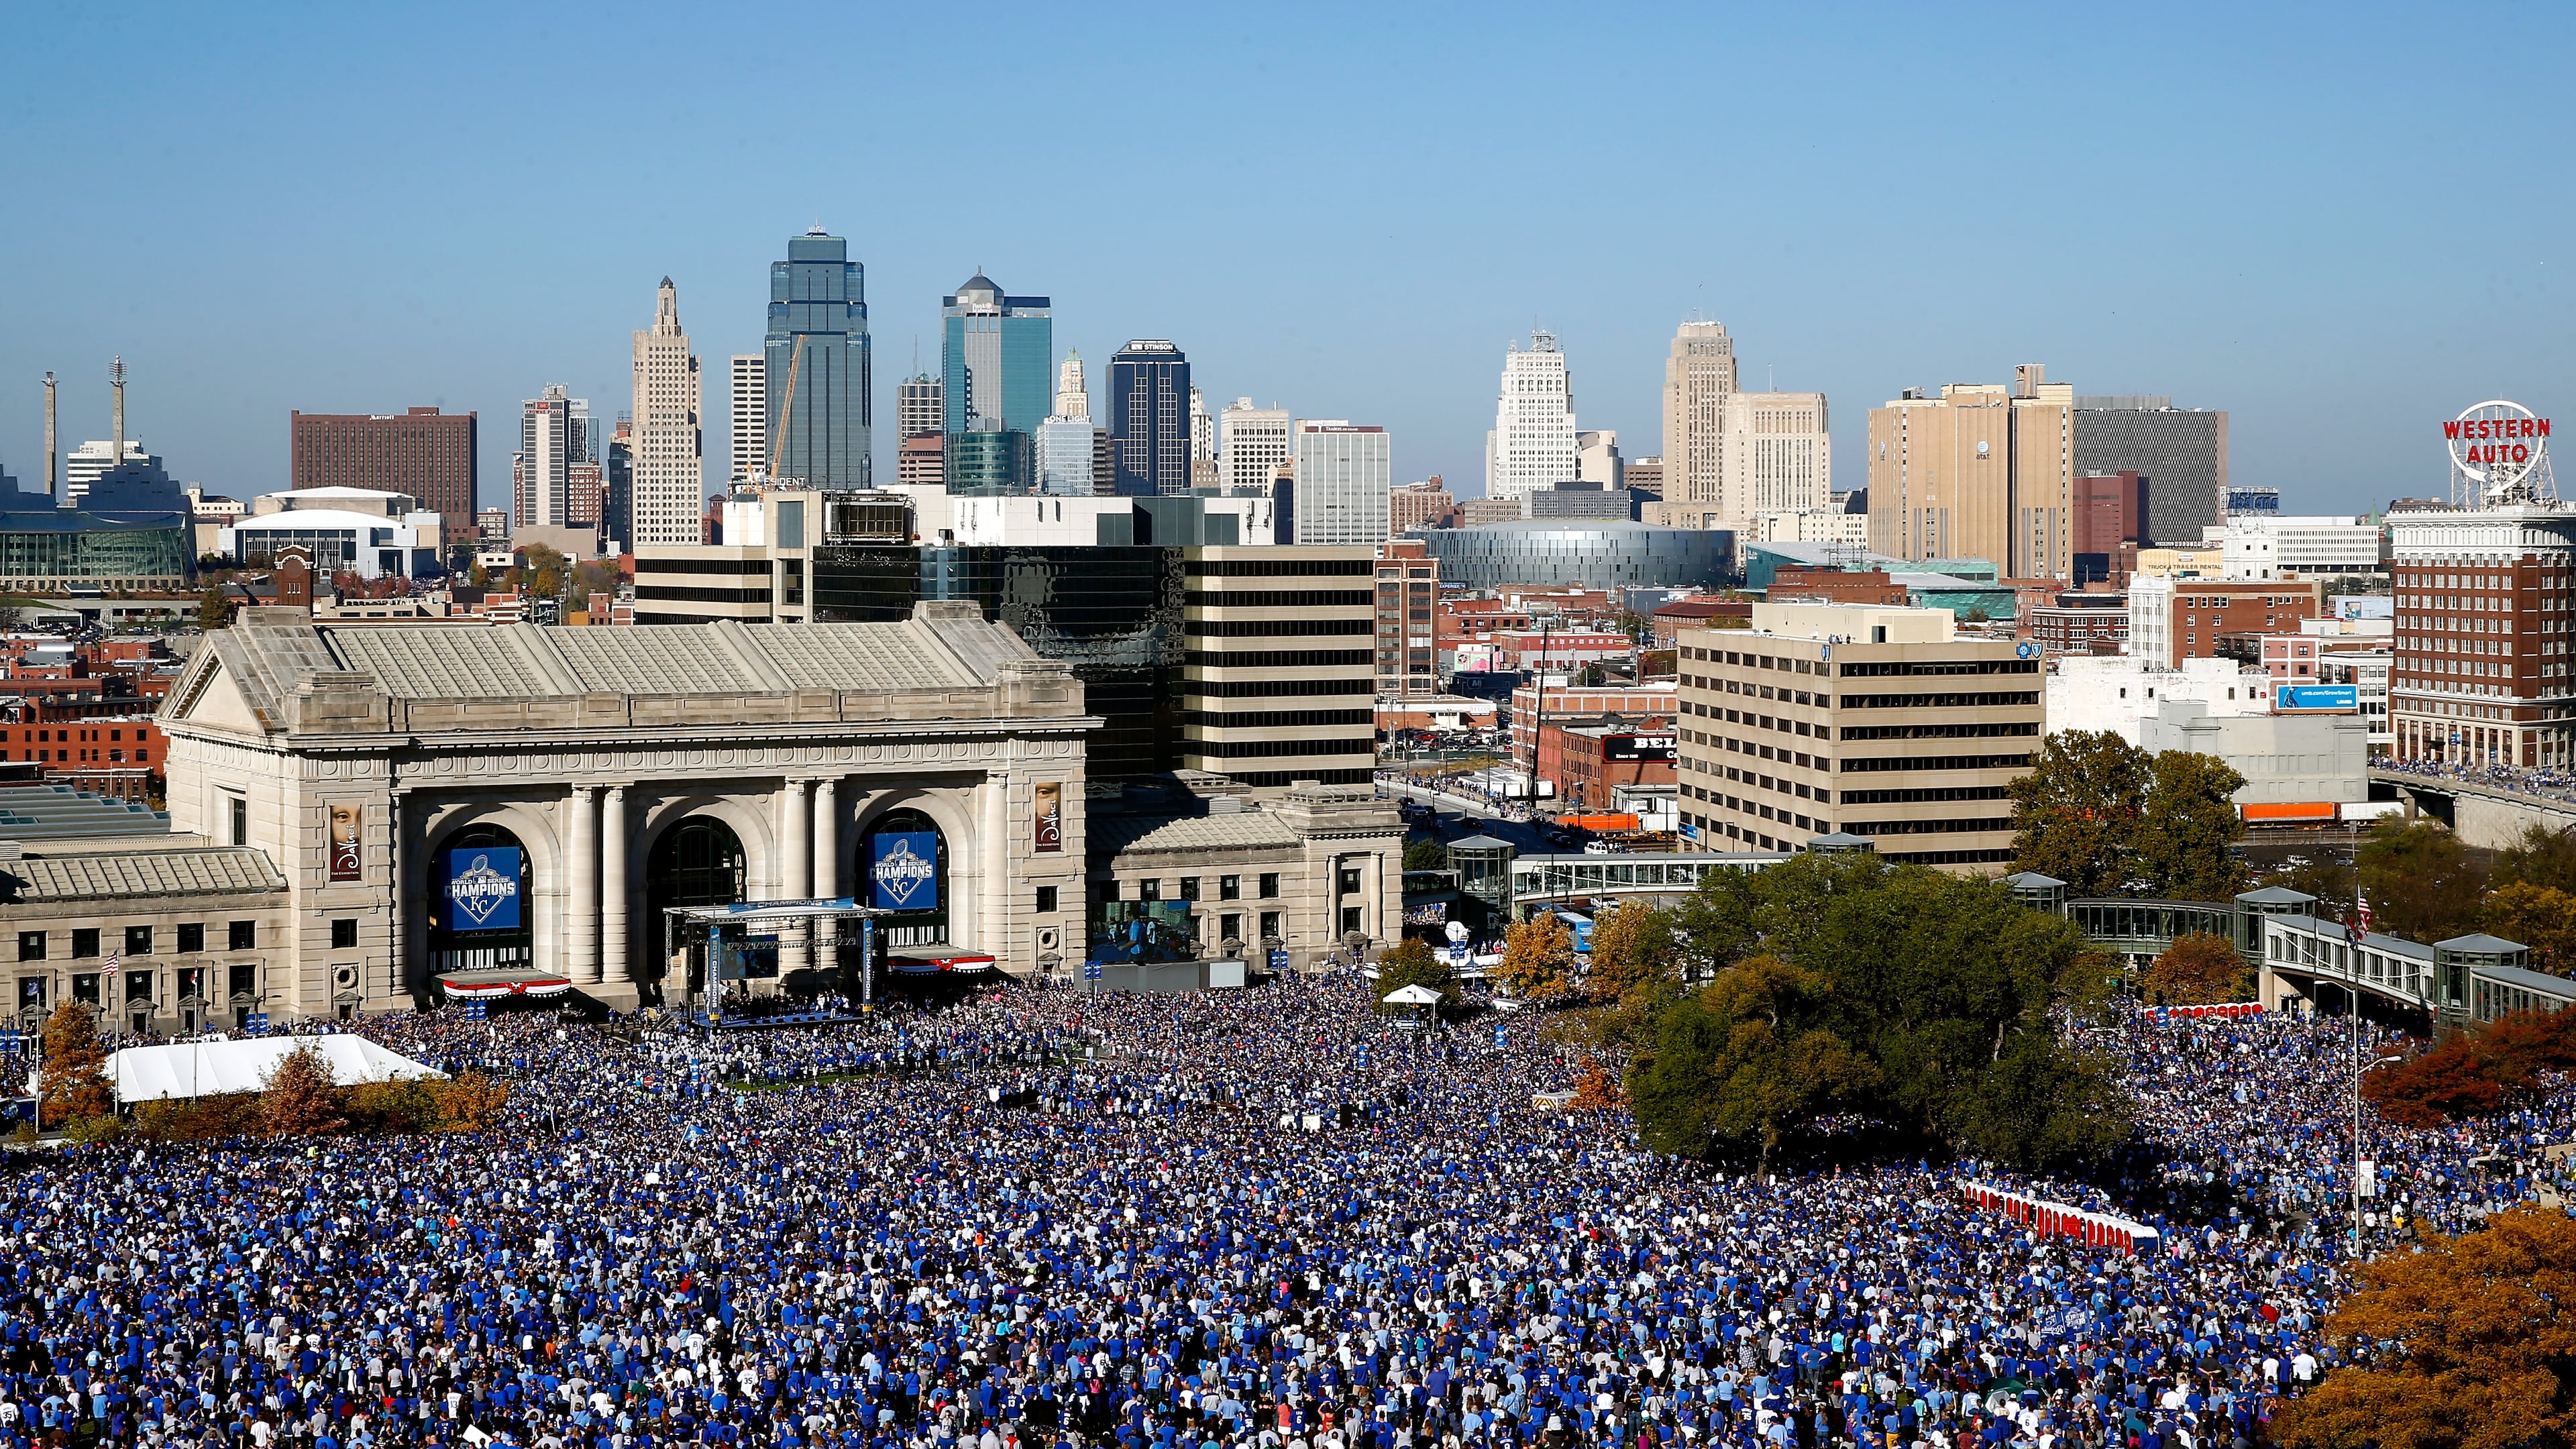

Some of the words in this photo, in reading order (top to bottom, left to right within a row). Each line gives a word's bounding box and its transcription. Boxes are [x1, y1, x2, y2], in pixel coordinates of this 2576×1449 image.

[2443, 419, 2551, 440] WESTERN
[2466, 443, 2528, 463] AUTO
[1634, 737, 1677, 748] BEL
[869, 864, 934, 881] CHAMPIONS
[444, 881, 517, 898] CHAMPIONS
[892, 878, 908, 896] KC
[470, 896, 488, 914] KC
[757, 899, 824, 909] CHAMPIONS
[853, 1381, 863, 1389] 35
[1540, 1379, 1550, 1387] 35
